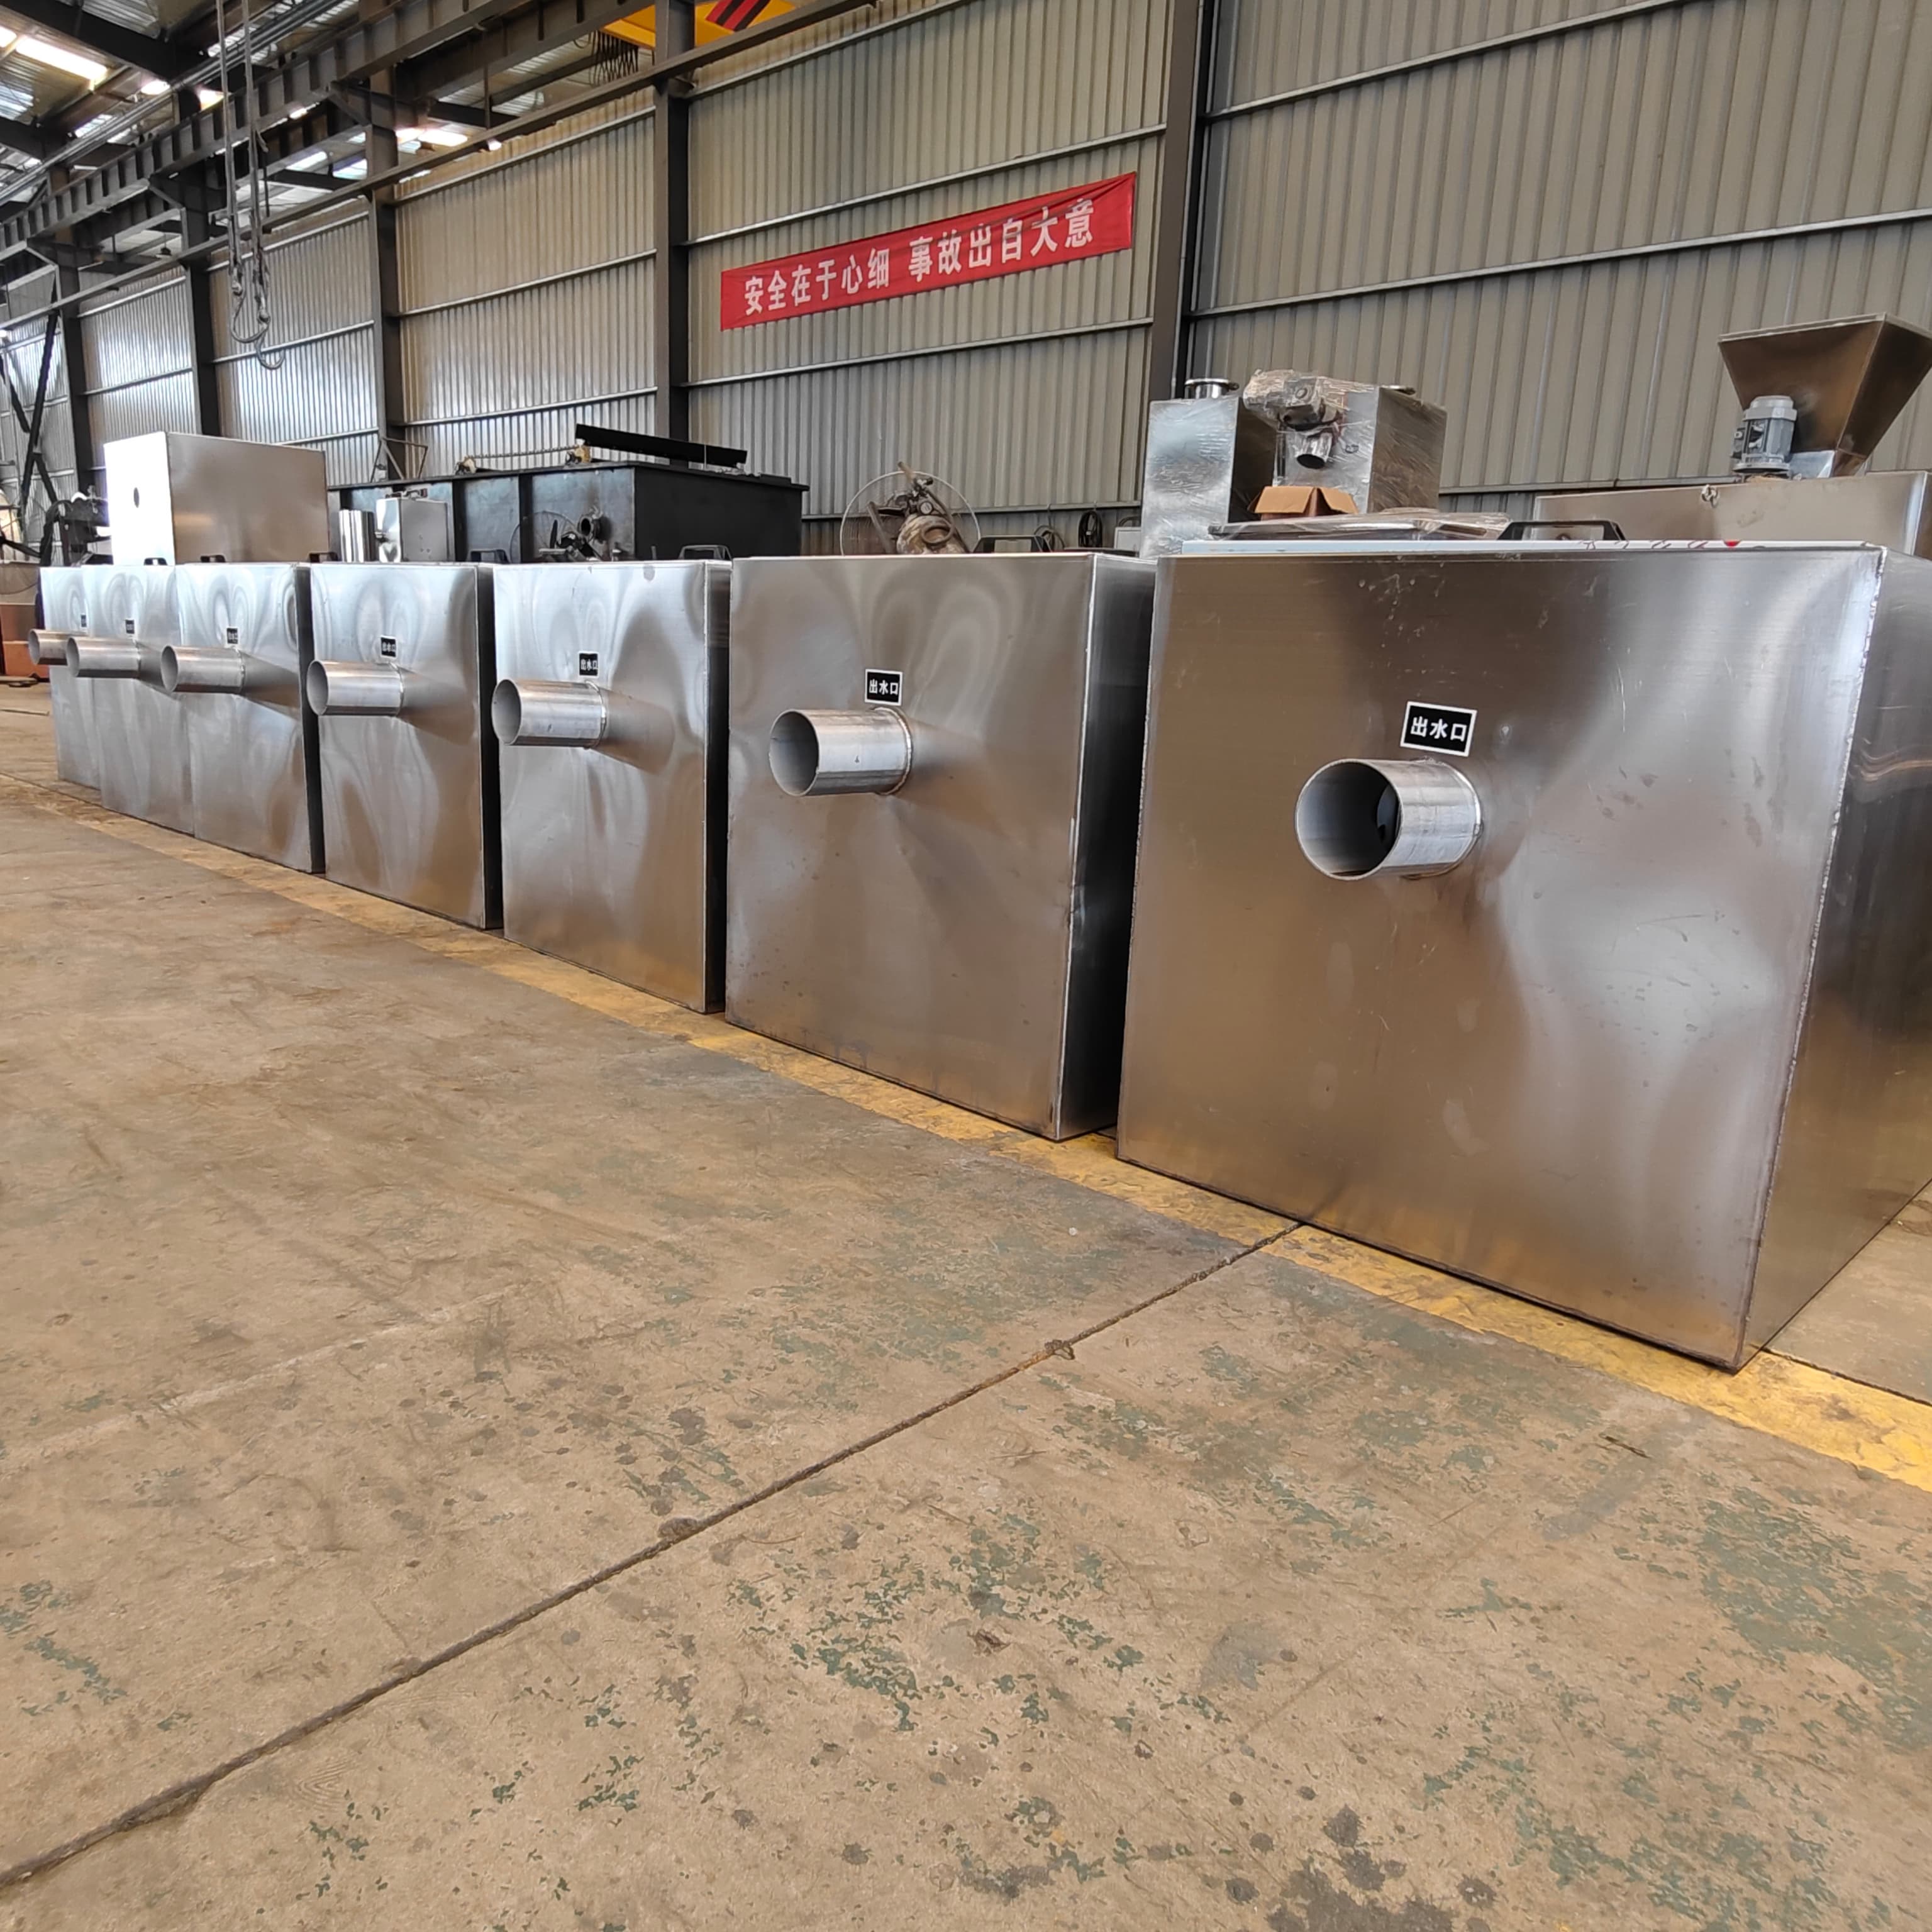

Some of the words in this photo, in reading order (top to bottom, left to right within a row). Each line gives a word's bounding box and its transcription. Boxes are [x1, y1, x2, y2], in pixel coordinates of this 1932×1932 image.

[745, 248, 890, 316] 安全在于心细
[909, 198, 1094, 282] 事故出自大意
[869, 679, 899, 695] 出水口
[1410, 716, 1467, 742] 出水口
